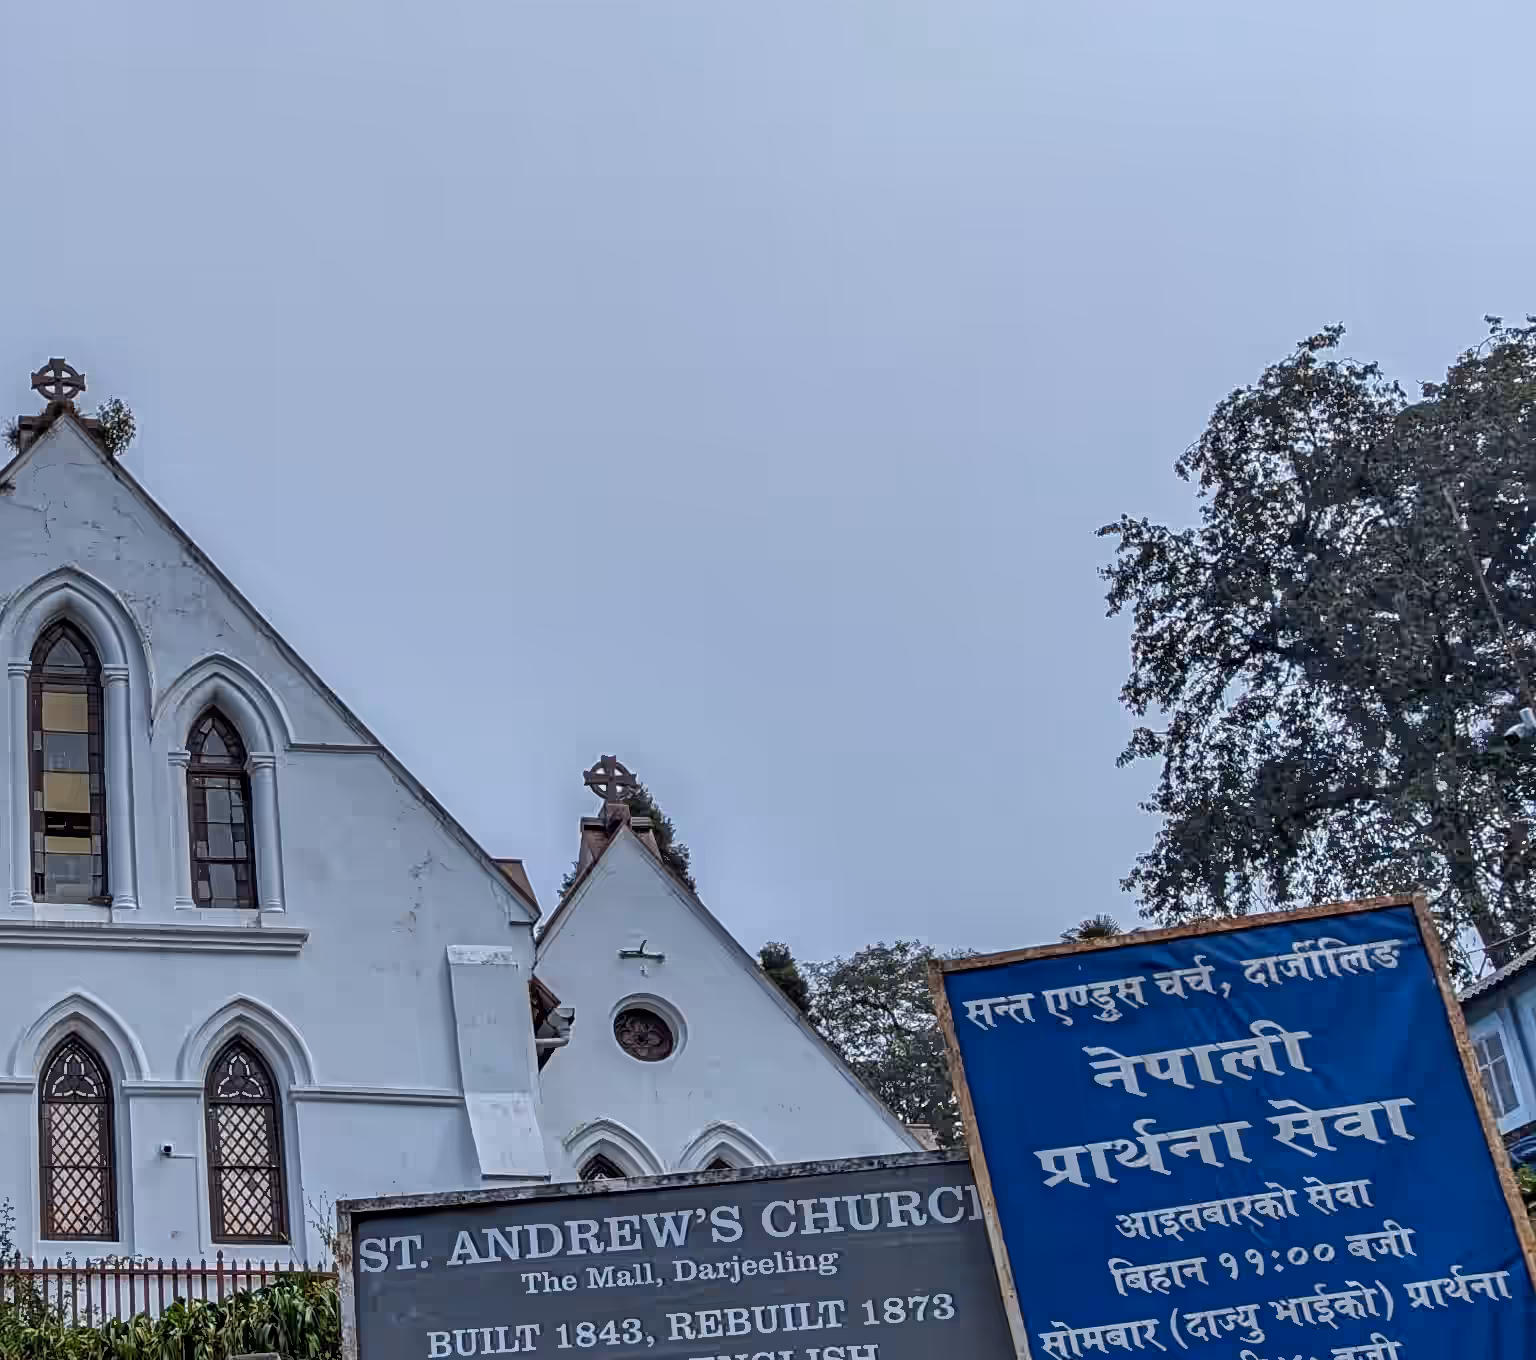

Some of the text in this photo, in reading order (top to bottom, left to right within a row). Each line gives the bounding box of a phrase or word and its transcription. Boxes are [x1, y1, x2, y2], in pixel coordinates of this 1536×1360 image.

[963, 993, 1035, 1028] सन्त
[1154, 955, 1230, 998] चर्च,
[1082, 1020, 1312, 1096] नेपाली
[1034, 1098, 1414, 1187] प्रार्थना सेवा
[360, 1235, 428, 1272] ST.
[447, 1206, 742, 1266] ANDREW'S
[1116, 1177, 1373, 1241] आइतबारको सेवा
[521, 1251, 838, 1294] The Mall, Darjeeling
[1108, 1257, 1208, 1296] बिहान
[427, 1294, 954, 1358] BUILT 1843, REBUILT 1873
[1040, 1319, 1166, 1360] सोमबार
[1403, 1265, 1512, 1309] प्रार्थना
